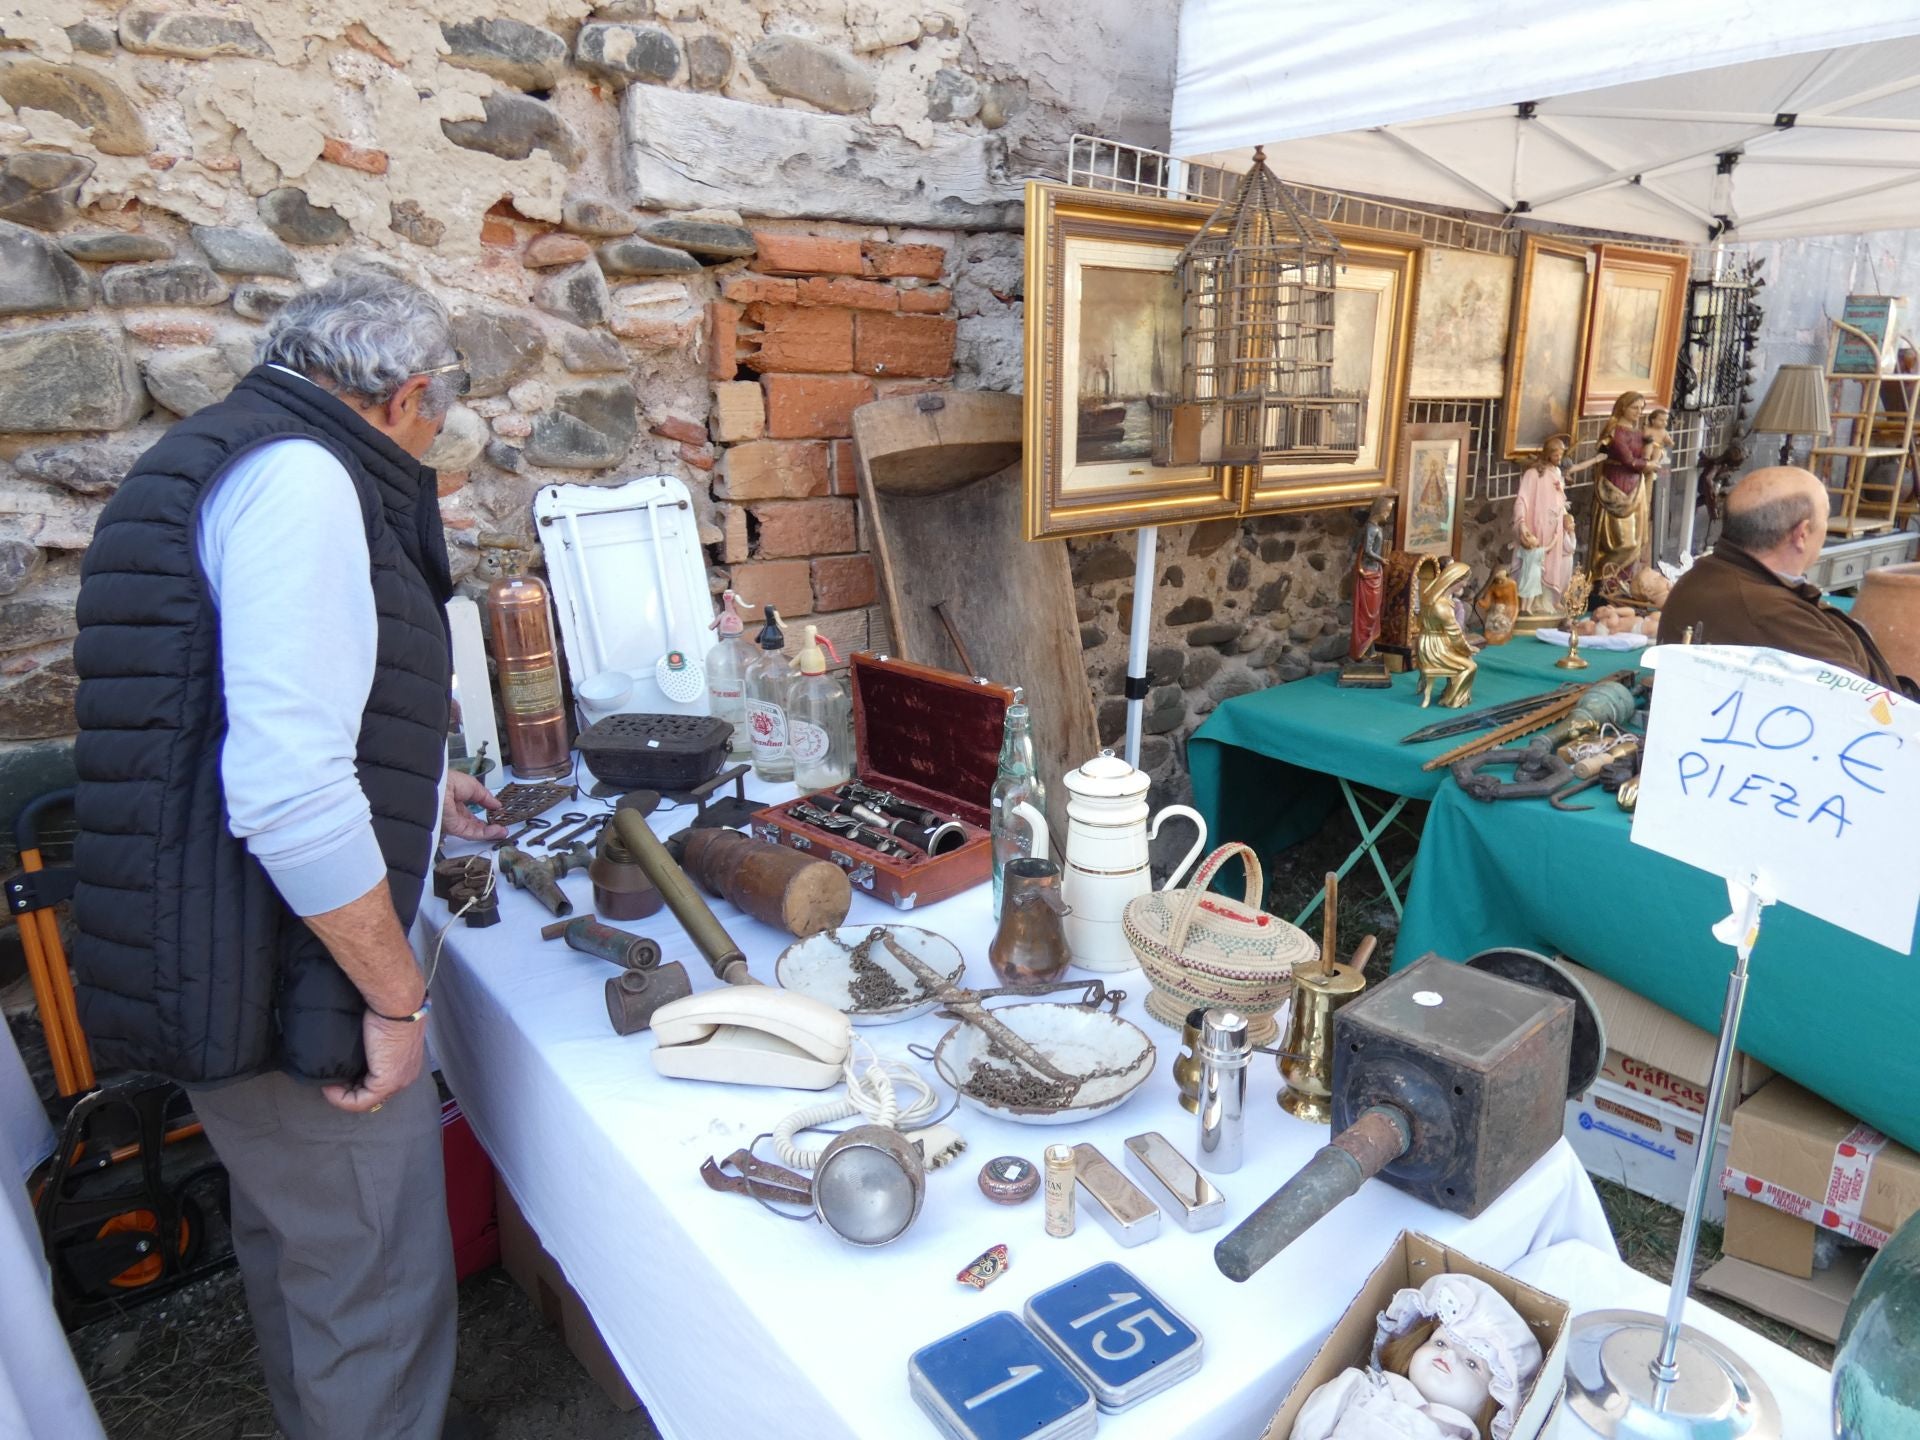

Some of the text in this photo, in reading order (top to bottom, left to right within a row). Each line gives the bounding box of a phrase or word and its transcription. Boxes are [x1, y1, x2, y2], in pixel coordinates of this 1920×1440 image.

[1677, 751, 1853, 839] PIEZA
[1621, 1057, 1706, 1104] Gráficas
[1767, 1184, 1812, 1210] BREEKBAAR
[1772, 1195, 1803, 1214] FRAGILE
[1837, 1174, 1852, 1204] FRAGILE
[1068, 1291, 1178, 1361] 15
[963, 1363, 1044, 1410] 1
